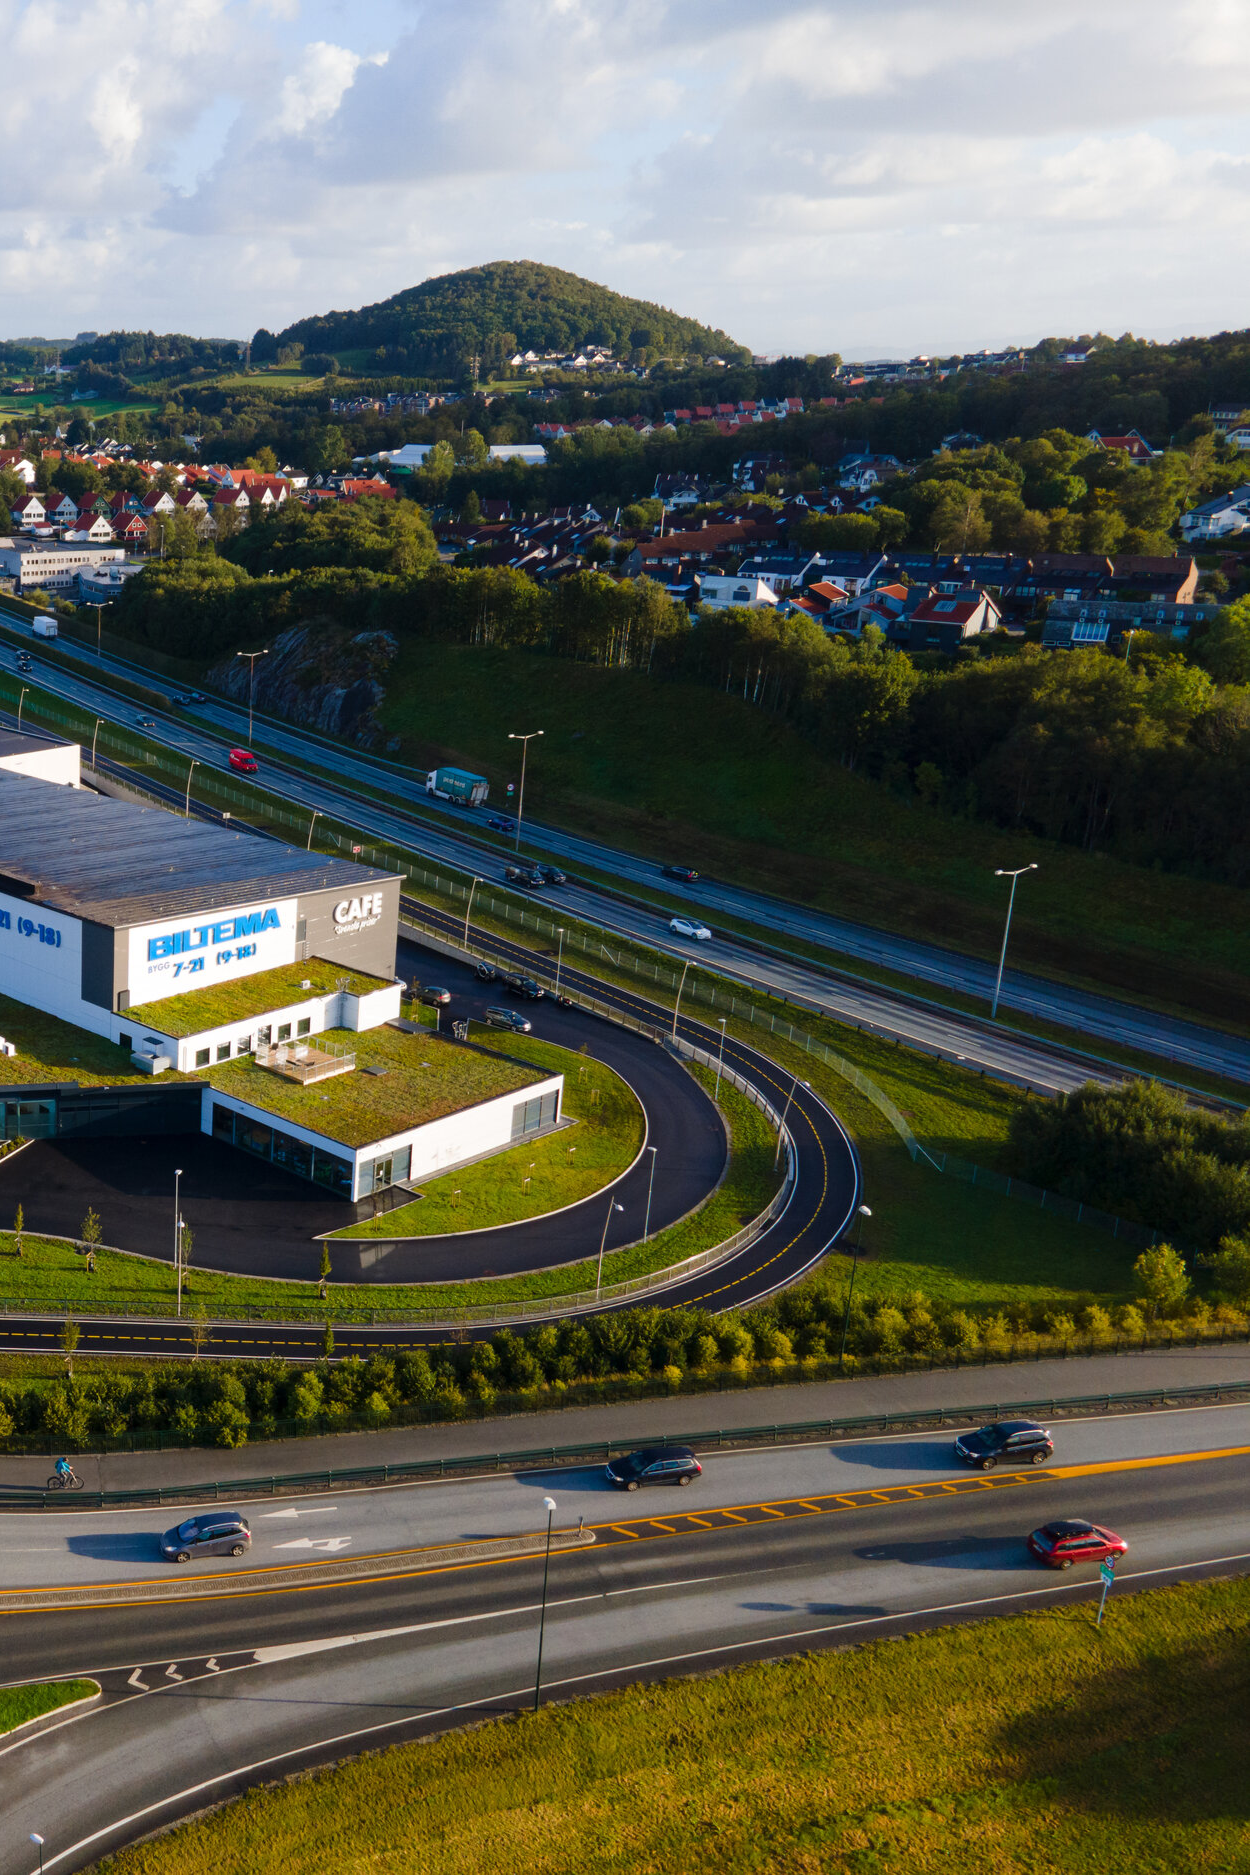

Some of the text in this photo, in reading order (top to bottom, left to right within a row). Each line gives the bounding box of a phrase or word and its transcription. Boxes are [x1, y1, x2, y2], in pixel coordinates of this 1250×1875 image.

[333, 892, 382, 923] CAFE
[17, 915, 62, 948] (9-18)
[147, 908, 281, 961] BILTEMA
[148, 942, 257, 978] BYGG 7-21 (9-18)
